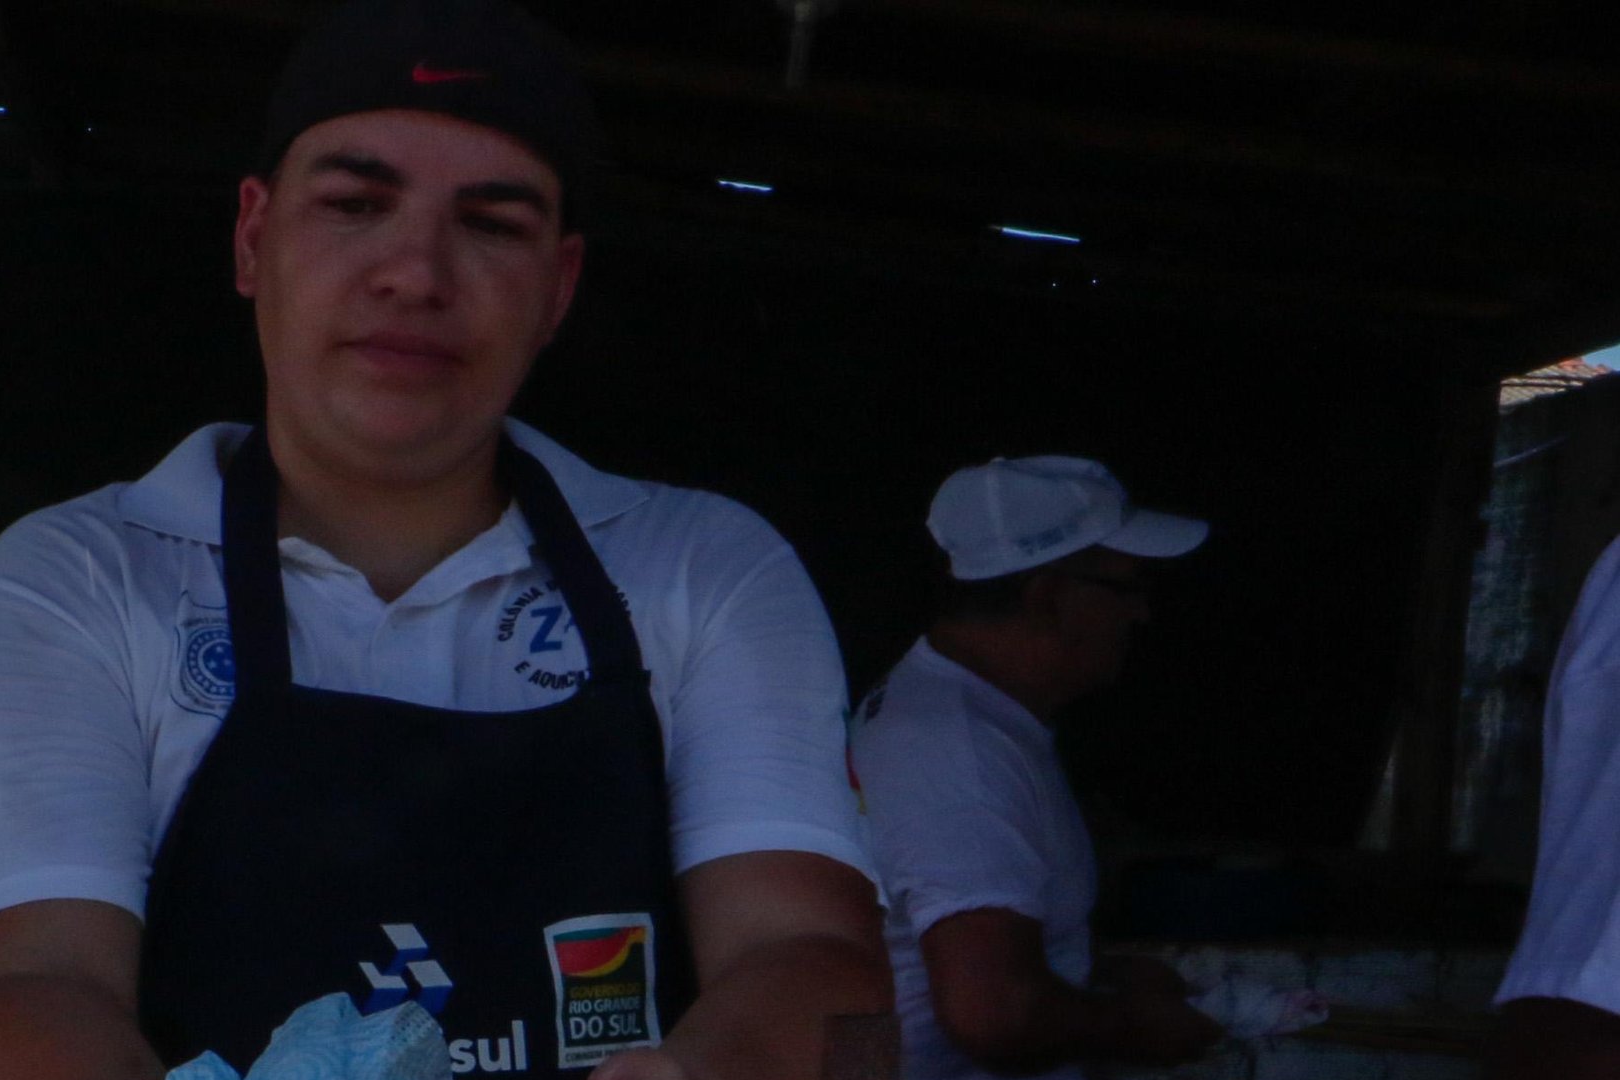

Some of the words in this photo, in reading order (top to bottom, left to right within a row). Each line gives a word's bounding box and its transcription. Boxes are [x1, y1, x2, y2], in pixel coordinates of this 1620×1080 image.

[514, 660, 531, 674] E
[568, 998, 592, 1014] RIO
[594, 996, 642, 1013] GRANDE
[569, 1015, 604, 1039] DO
[608, 1012, 642, 1037] SUL
[448, 1019, 528, 1073] sul
